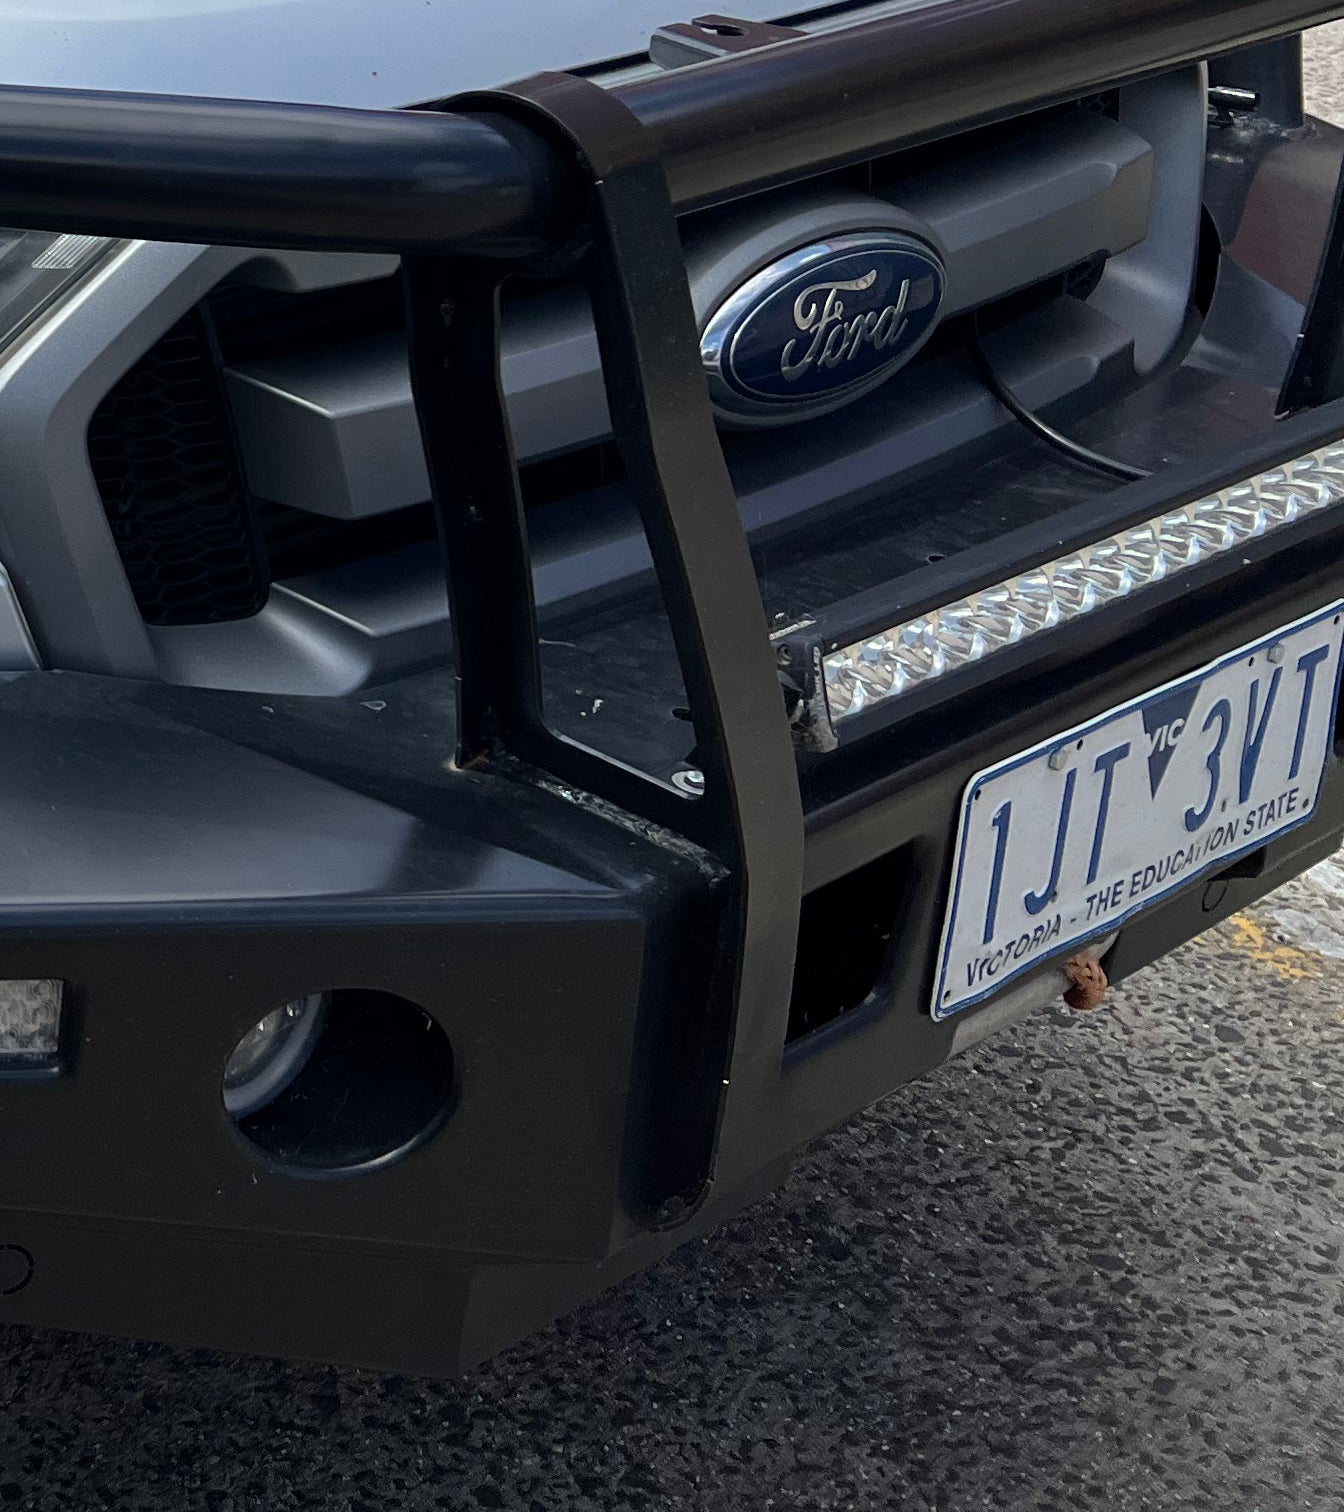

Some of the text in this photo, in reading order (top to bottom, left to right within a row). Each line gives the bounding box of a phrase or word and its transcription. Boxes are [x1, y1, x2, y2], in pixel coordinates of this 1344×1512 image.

[781, 268, 910, 381] Ford
[965, 913, 1062, 988] VICTORIA
[1085, 878, 1125, 921] THE
[1242, 787, 1301, 836] STATE
